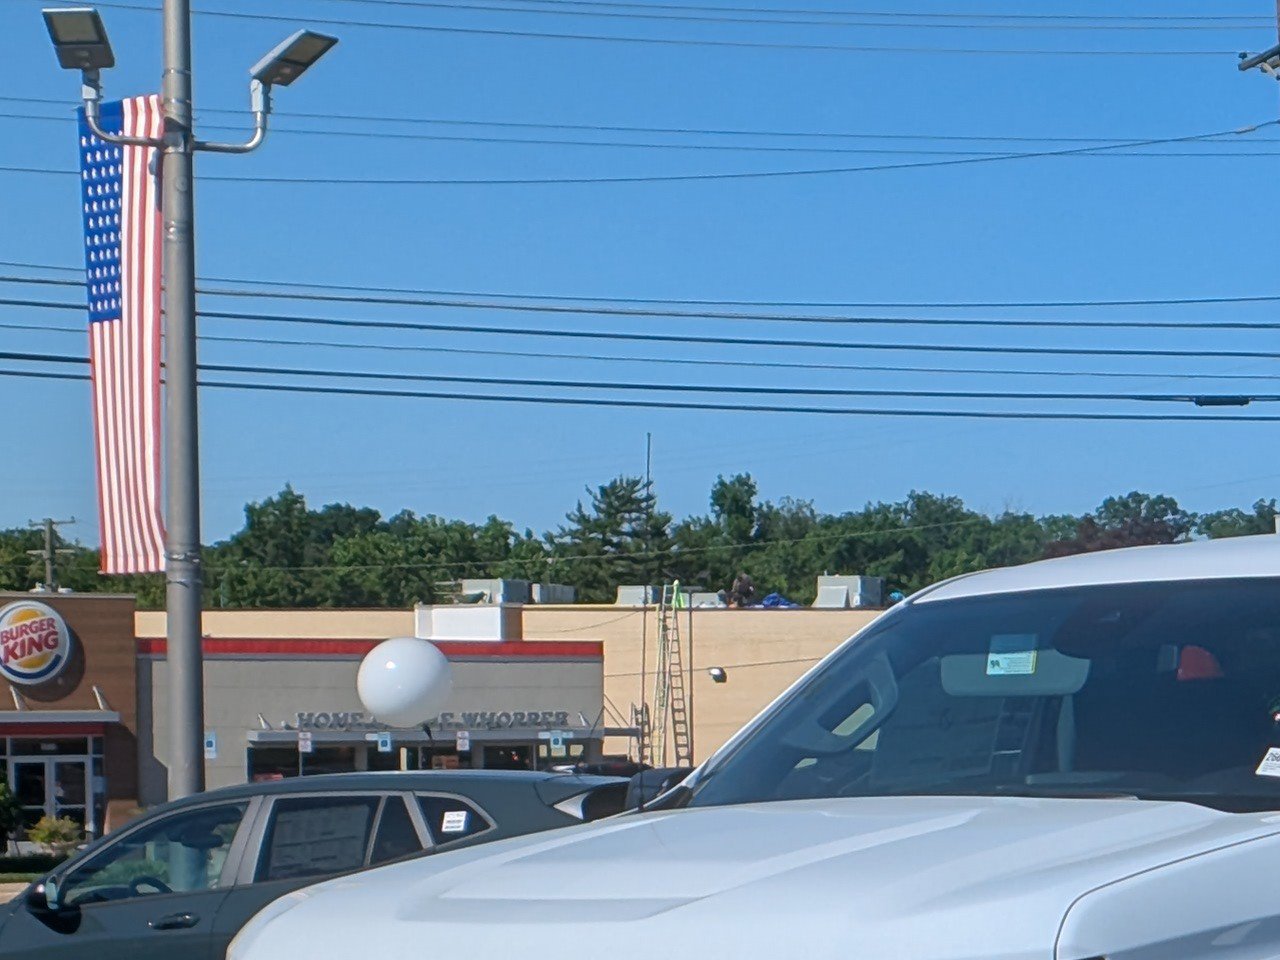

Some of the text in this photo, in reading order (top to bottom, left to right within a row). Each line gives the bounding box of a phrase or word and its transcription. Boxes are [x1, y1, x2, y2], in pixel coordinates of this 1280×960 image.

[0, 617, 56, 645] BURGER
[3, 630, 59, 664] KING
[297, 712, 364, 729] HOME
[461, 711, 569, 728] WHOPPER
